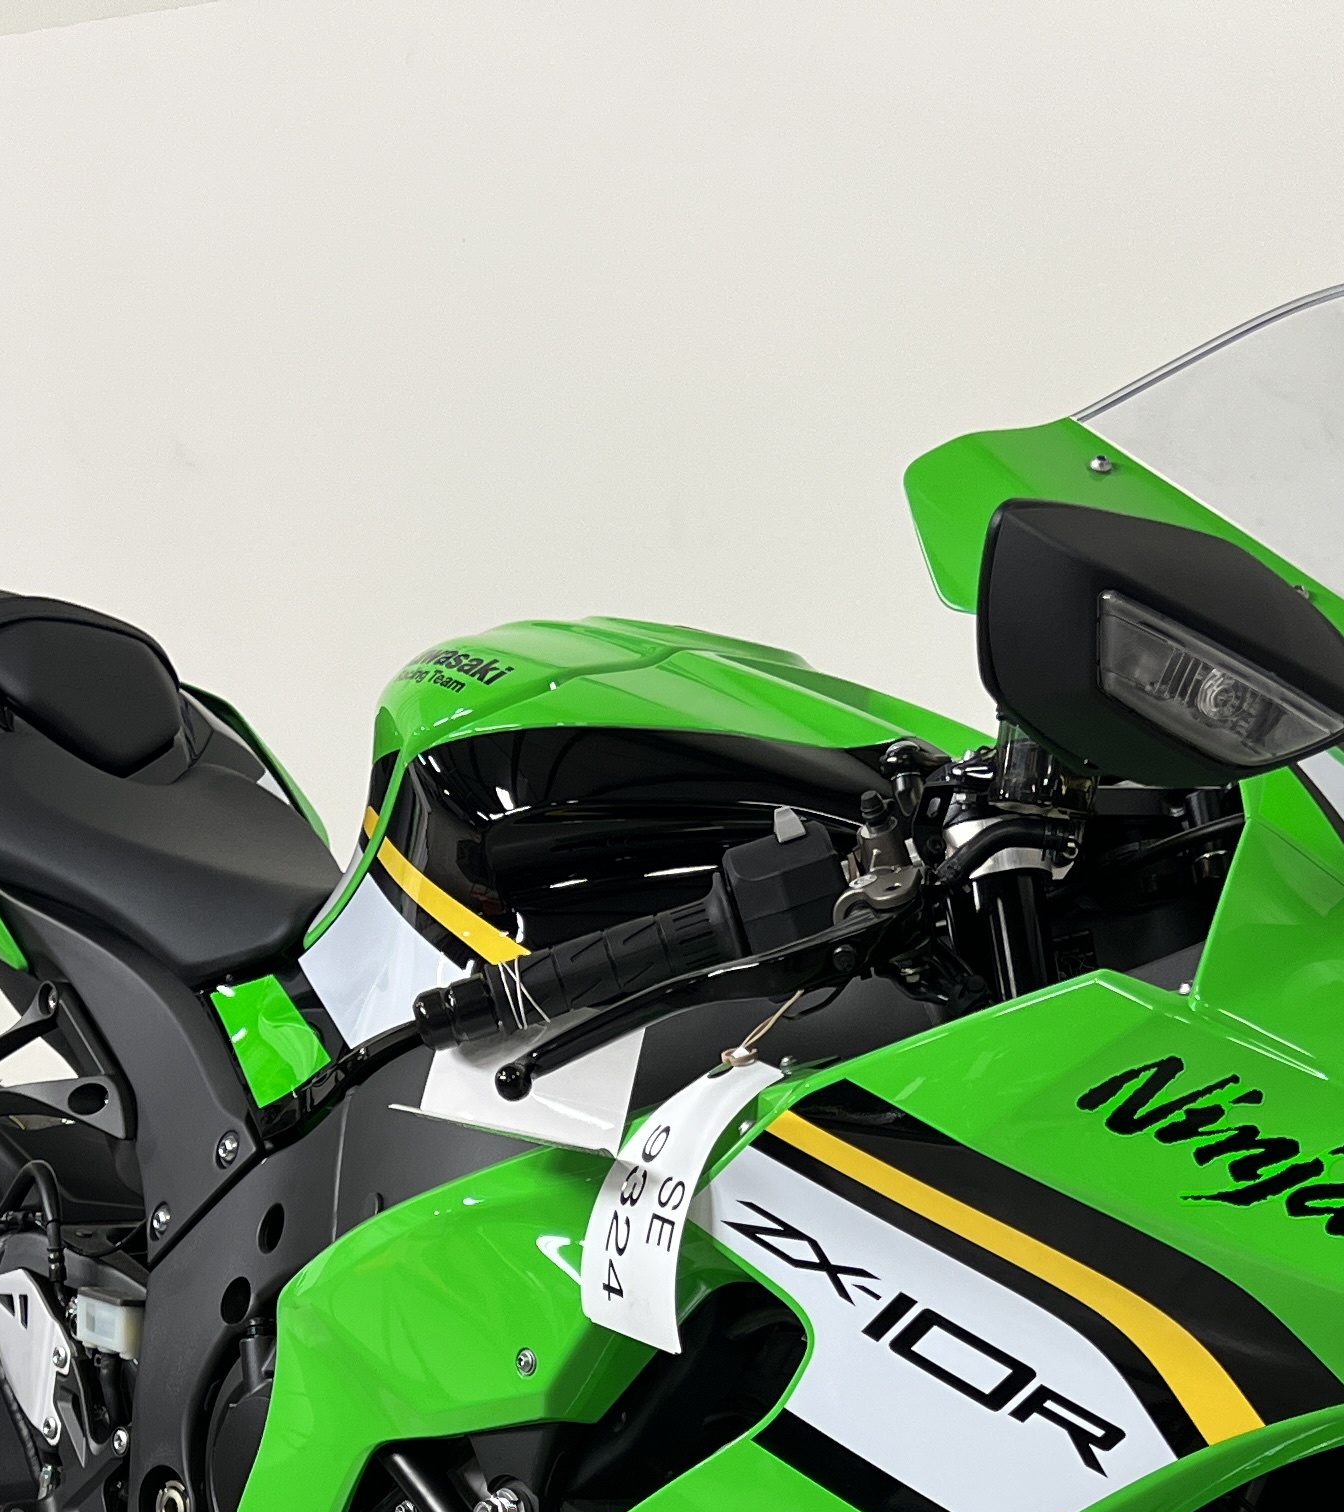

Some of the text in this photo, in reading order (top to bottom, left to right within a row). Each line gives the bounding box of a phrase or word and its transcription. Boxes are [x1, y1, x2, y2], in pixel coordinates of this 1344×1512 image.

[427, 669, 467, 693] Team
[602, 1124, 671, 1302] 9324
[645, 1176, 686, 1252] SE
[720, 1199, 1127, 1478] ZX-10R
